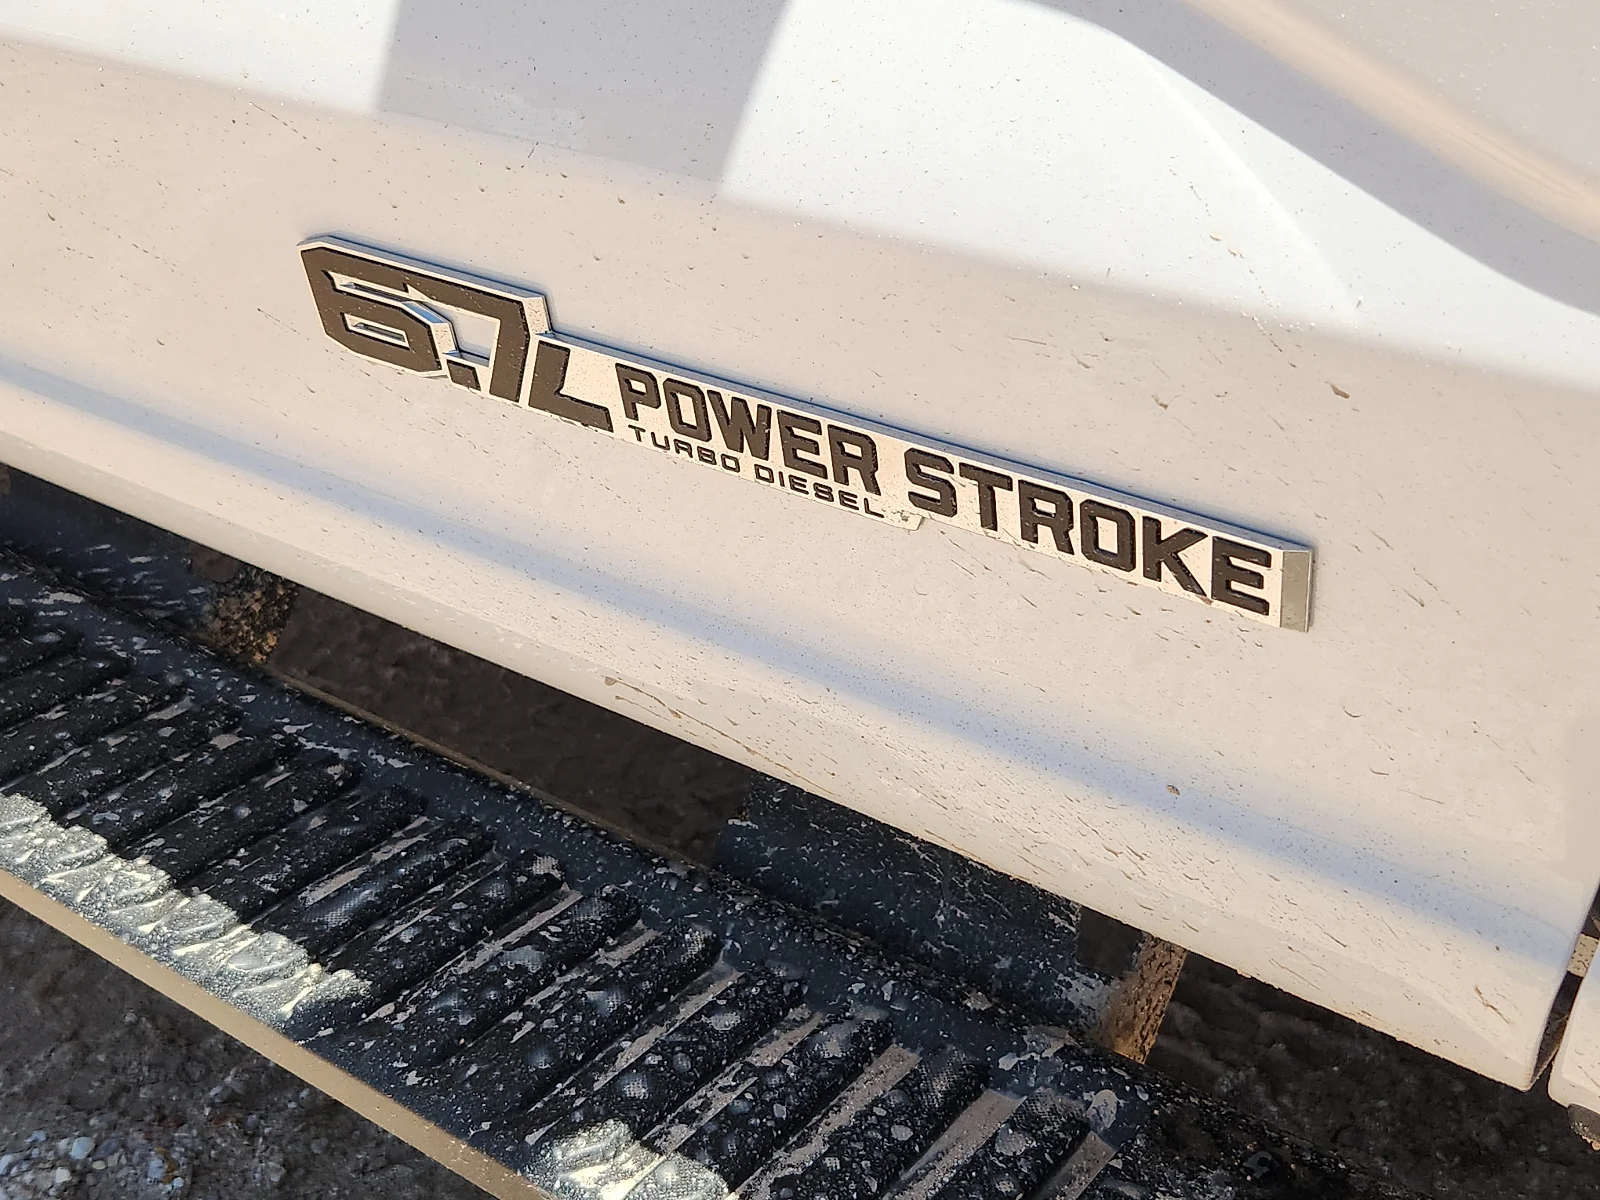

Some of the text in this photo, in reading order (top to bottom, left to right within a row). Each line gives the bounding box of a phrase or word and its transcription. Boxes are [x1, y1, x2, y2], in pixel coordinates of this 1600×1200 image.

[299, 246, 1272, 616] 6.7L POWER STROKE
[628, 424, 885, 519] TURBO DIESEL
